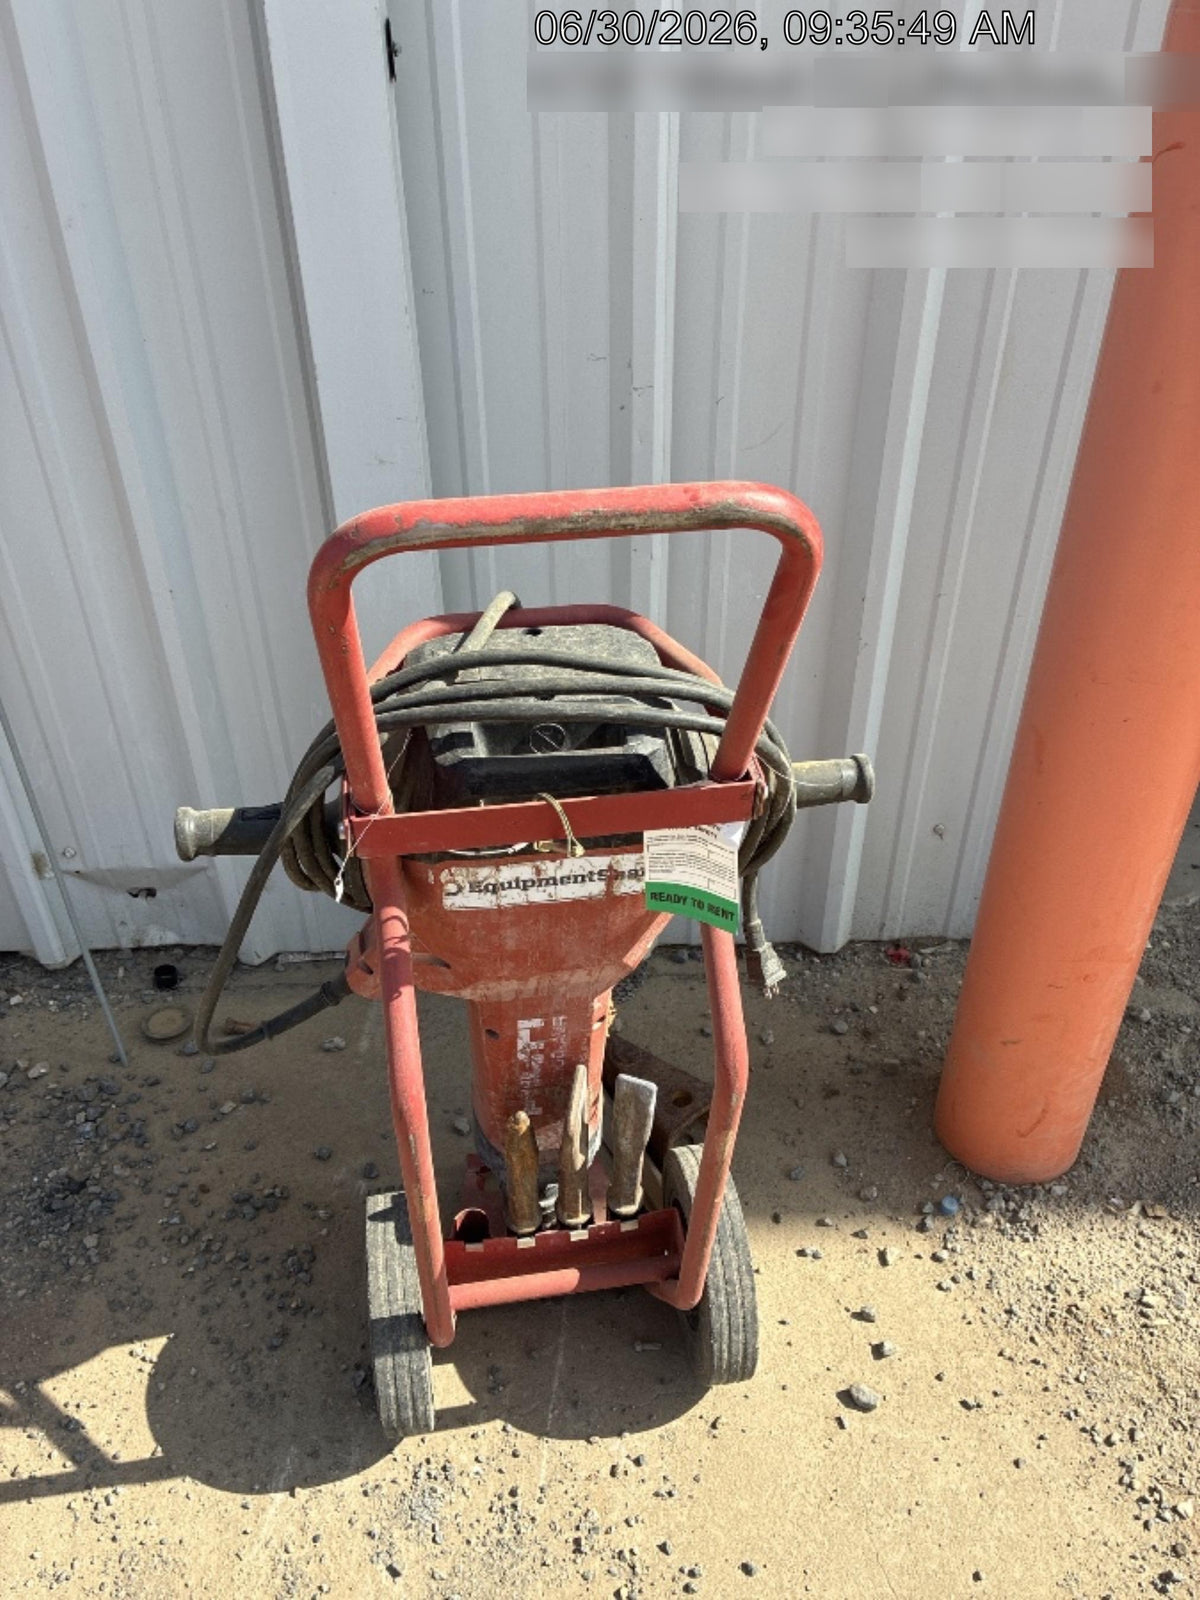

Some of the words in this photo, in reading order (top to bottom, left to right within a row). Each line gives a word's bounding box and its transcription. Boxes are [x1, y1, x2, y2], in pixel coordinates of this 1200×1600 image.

[650, 892, 687, 906] READY
[691, 898, 705, 910] TO
[707, 903, 735, 921] RENT
